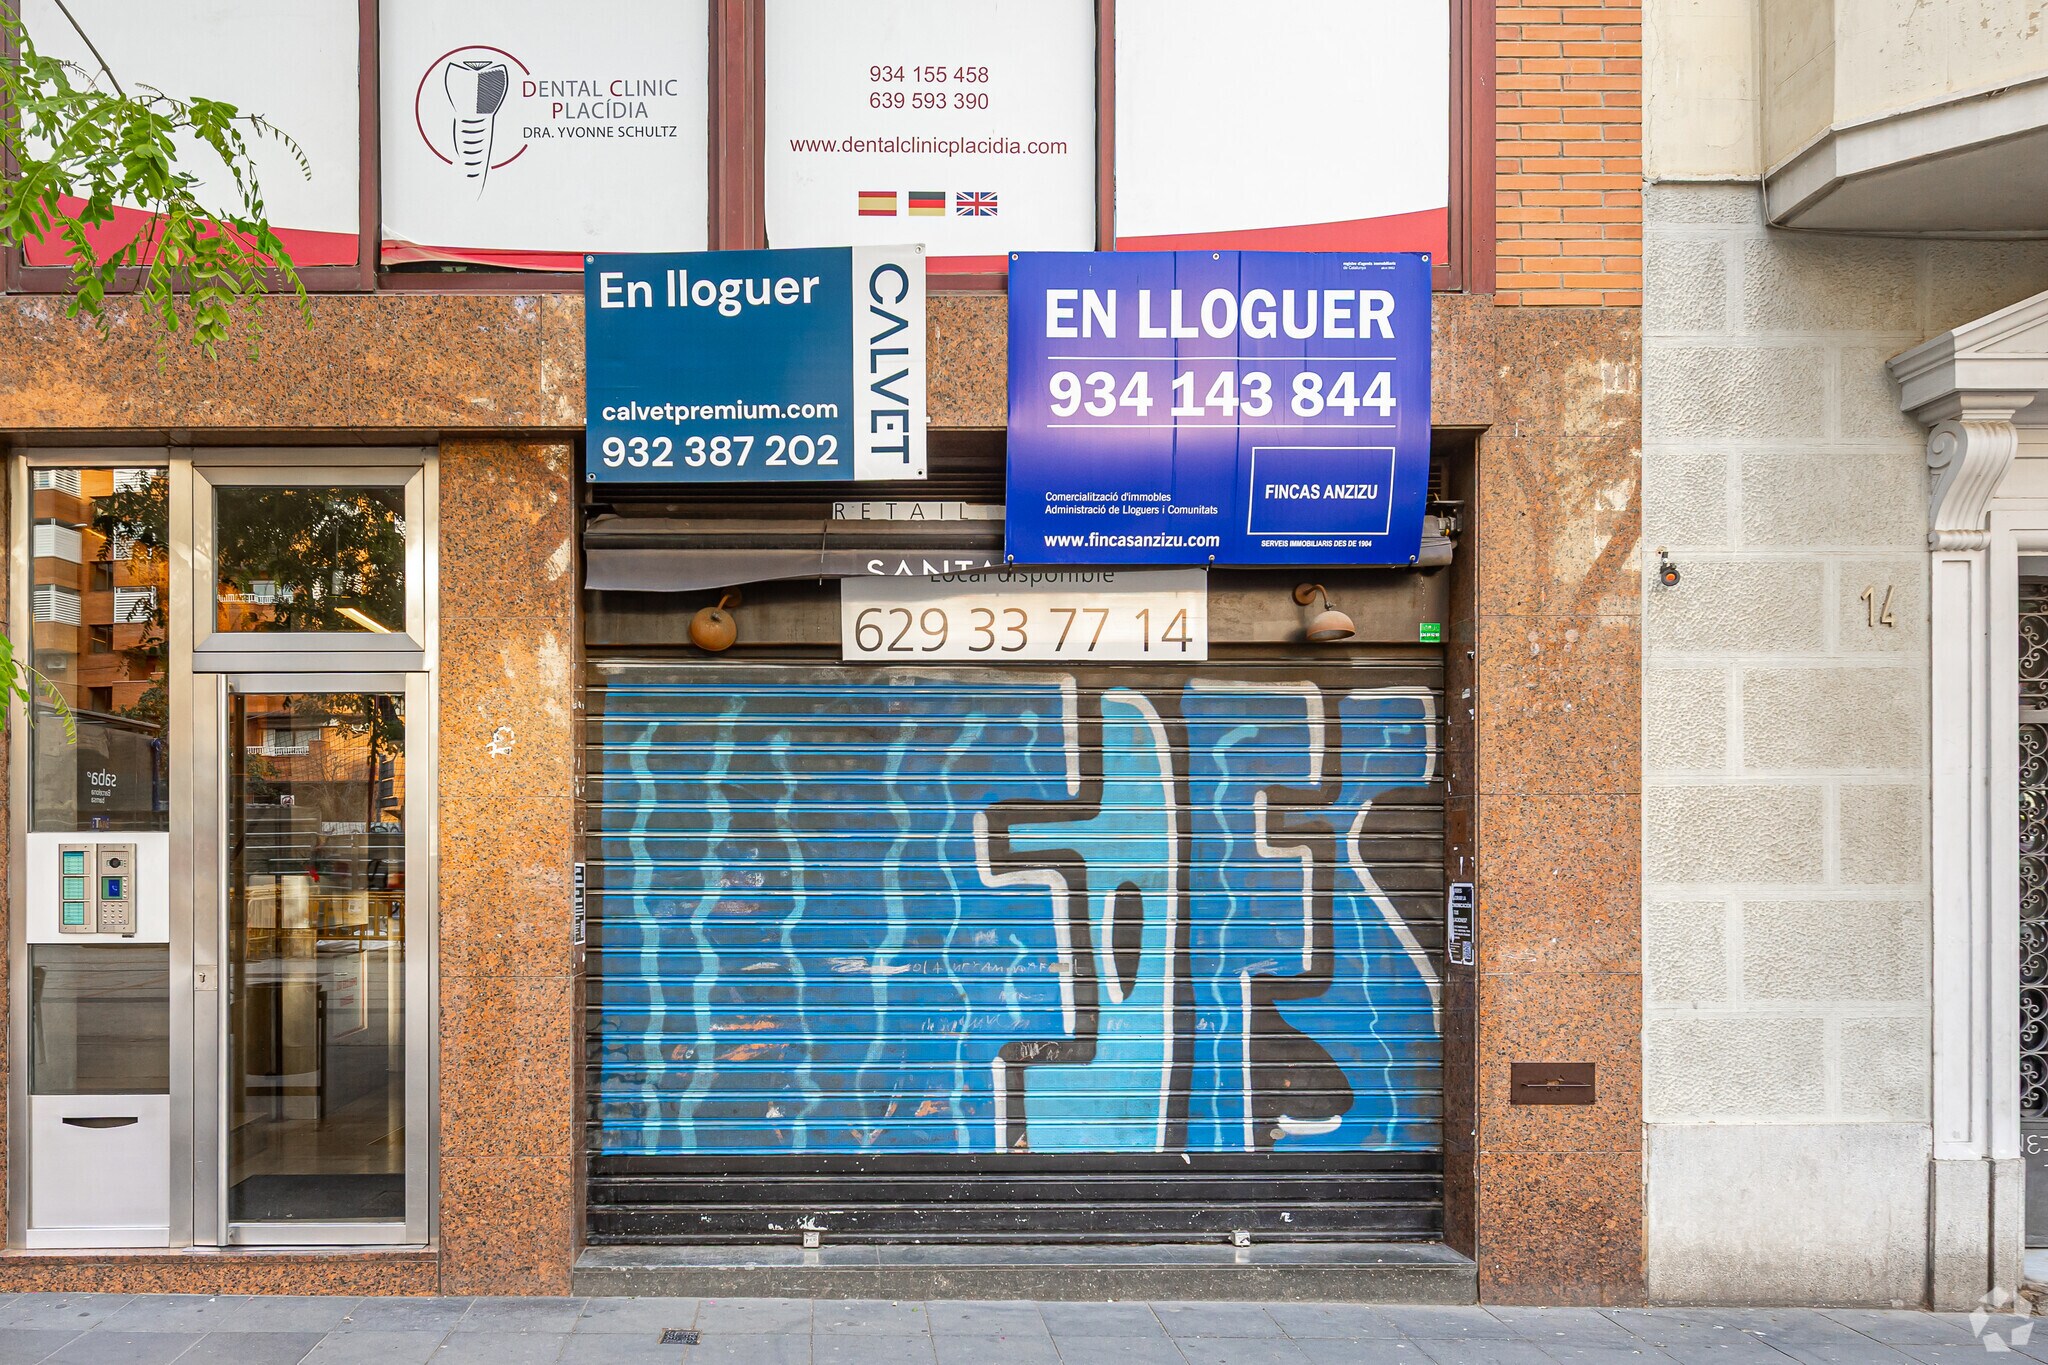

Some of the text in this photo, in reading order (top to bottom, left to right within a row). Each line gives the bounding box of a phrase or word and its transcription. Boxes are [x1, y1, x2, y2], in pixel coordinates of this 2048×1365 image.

[869, 65, 989, 84] 934 155 458
[522, 79, 678, 98] DENTAL CLINIC
[552, 99, 649, 119] PLACÍDIA
[869, 92, 989, 110] 639 593 390
[523, 125, 678, 139] DRA. YVONNE SCHULTZ
[789, 135, 1067, 158] www.dentalclinicplacidia.com
[600, 269, 820, 317] En lloguer
[1045, 287, 1396, 340] EN LLOGUER
[868, 263, 910, 464] CALVET
[1048, 371, 1397, 418] 934 143 844
[602, 400, 838, 426] calvetpremium.com
[602, 434, 839, 468] 932 387 202
[1045, 491, 1172, 502] Comercialització d'immobles
[1264, 484, 1379, 500] FINCAS ANZIZU
[835, 502, 969, 520] RETAIL
[1044, 504, 1219, 517] Administració de Lloguers i Comunitats
[1043, 531, 1221, 548] www.fincasanzizu.com
[1260, 539, 1289, 548] SERVEIS
[1333, 539, 1348, 548] DES
[1347, 539, 1358, 548] DE
[867, 559, 992, 576] SANT
[1861, 585, 1894, 628] 14
[855, 607, 1193, 653] 629 33 77 14
